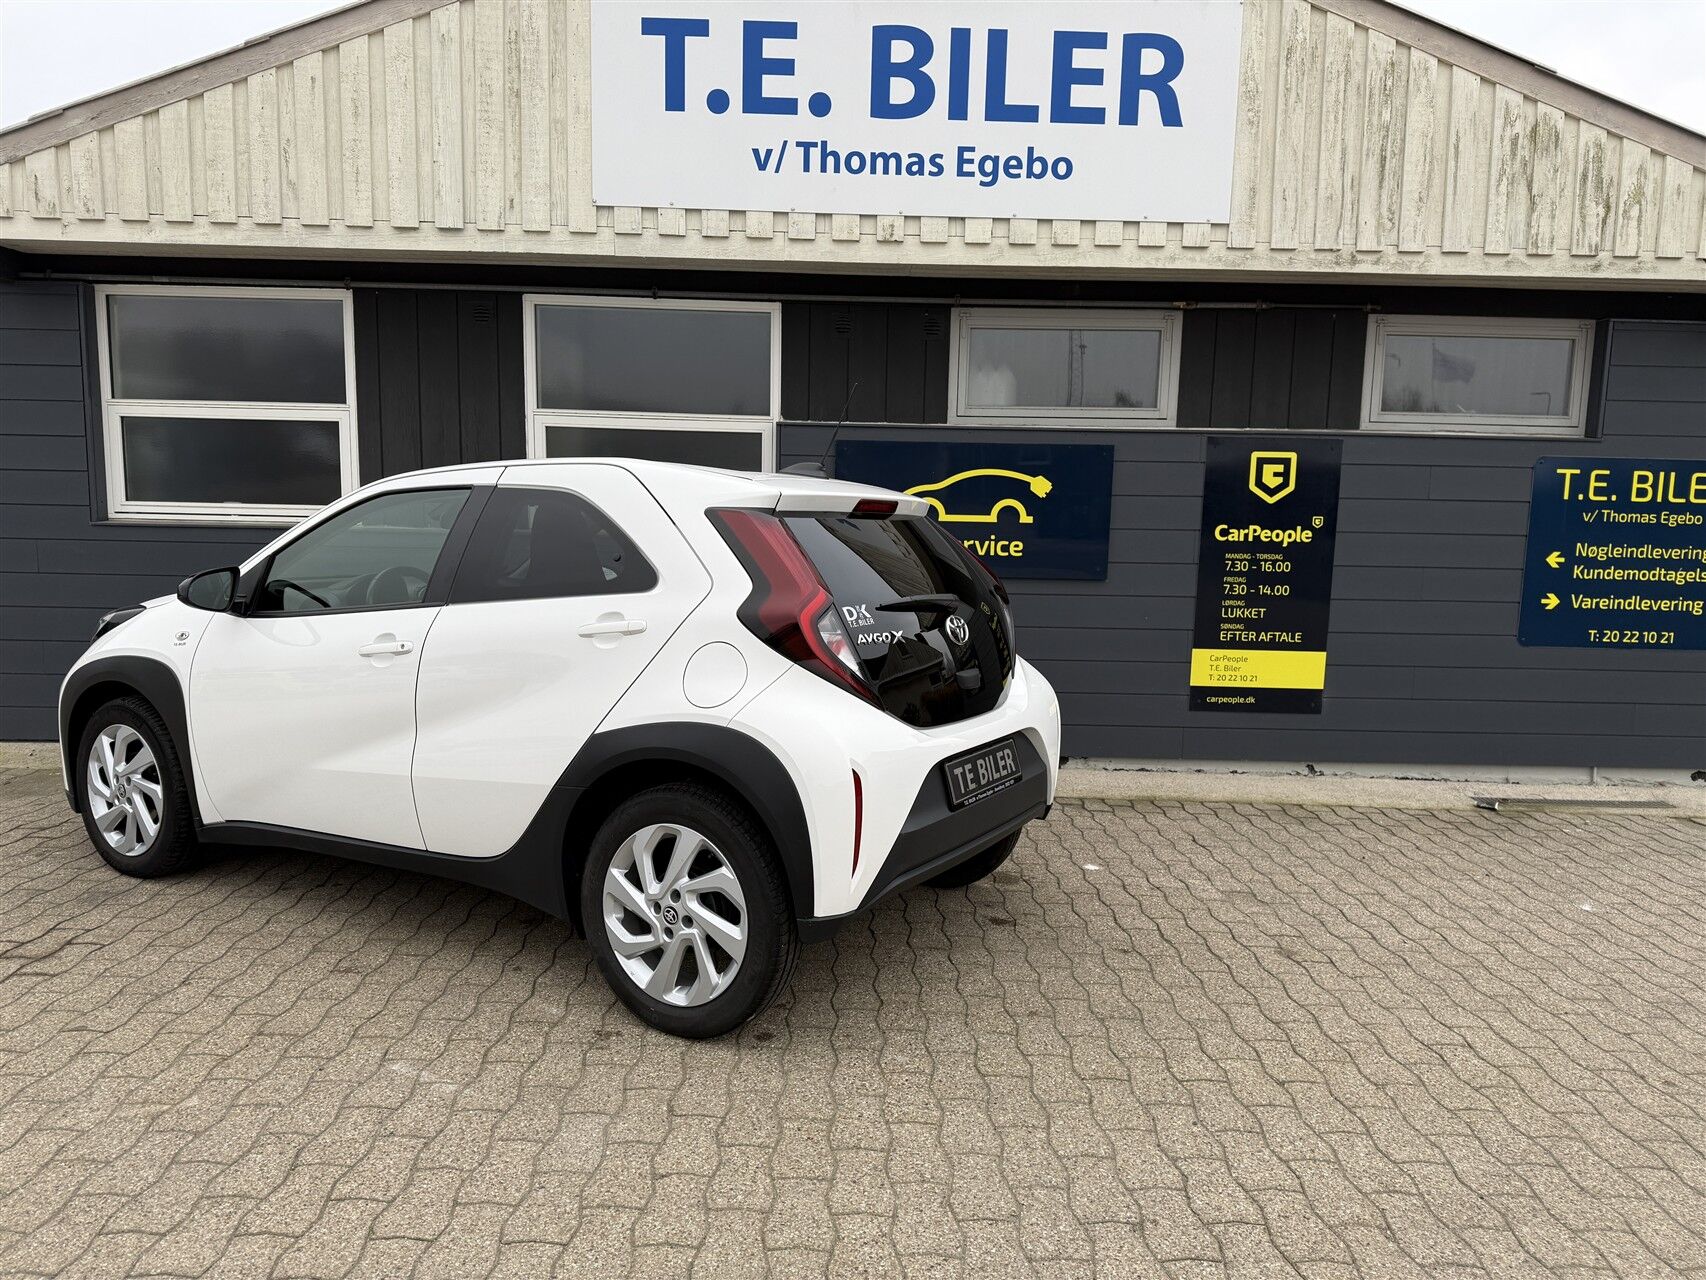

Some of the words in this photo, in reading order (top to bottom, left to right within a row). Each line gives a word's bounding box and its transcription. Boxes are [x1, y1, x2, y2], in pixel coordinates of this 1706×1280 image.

[641, 17, 832, 118] T.E.
[870, 24, 1185, 128] BILER
[751, 140, 788, 174] v/
[796, 141, 945, 177] Thomas
[956, 146, 1074, 187] Egebo
[1557, 469, 1616, 501] T.E.
[1583, 510, 1598, 522] v/
[1602, 510, 1656, 523] Thomas
[1661, 512, 1702, 526] Egebo
[1214, 524, 1313, 548] CarPeople
[1226, 561, 1248, 571] 7.30
[1260, 562, 1291, 572] 16.00
[1224, 584, 1246, 594] 7.30
[1259, 585, 1289, 595] 14.00
[1572, 594, 1704, 615] Vareindlevering
[1222, 608, 1266, 618] LUKKET
[858, 617, 875, 626] BILER
[1220, 631, 1256, 641] EFTER
[1258, 632, 1302, 642] AFTALE
[1589, 630, 1599, 641] T:
[1603, 631, 1619, 642] 20
[1623, 631, 1639, 642] 22
[1643, 632, 1657, 643] 10
[1660, 632, 1674, 643] 21
[1210, 655, 1248, 663] CarPeople
[1209, 674, 1215, 682] T:
[1207, 696, 1255, 704] carpeople.dk
[976, 748, 1017, 786] BILER
